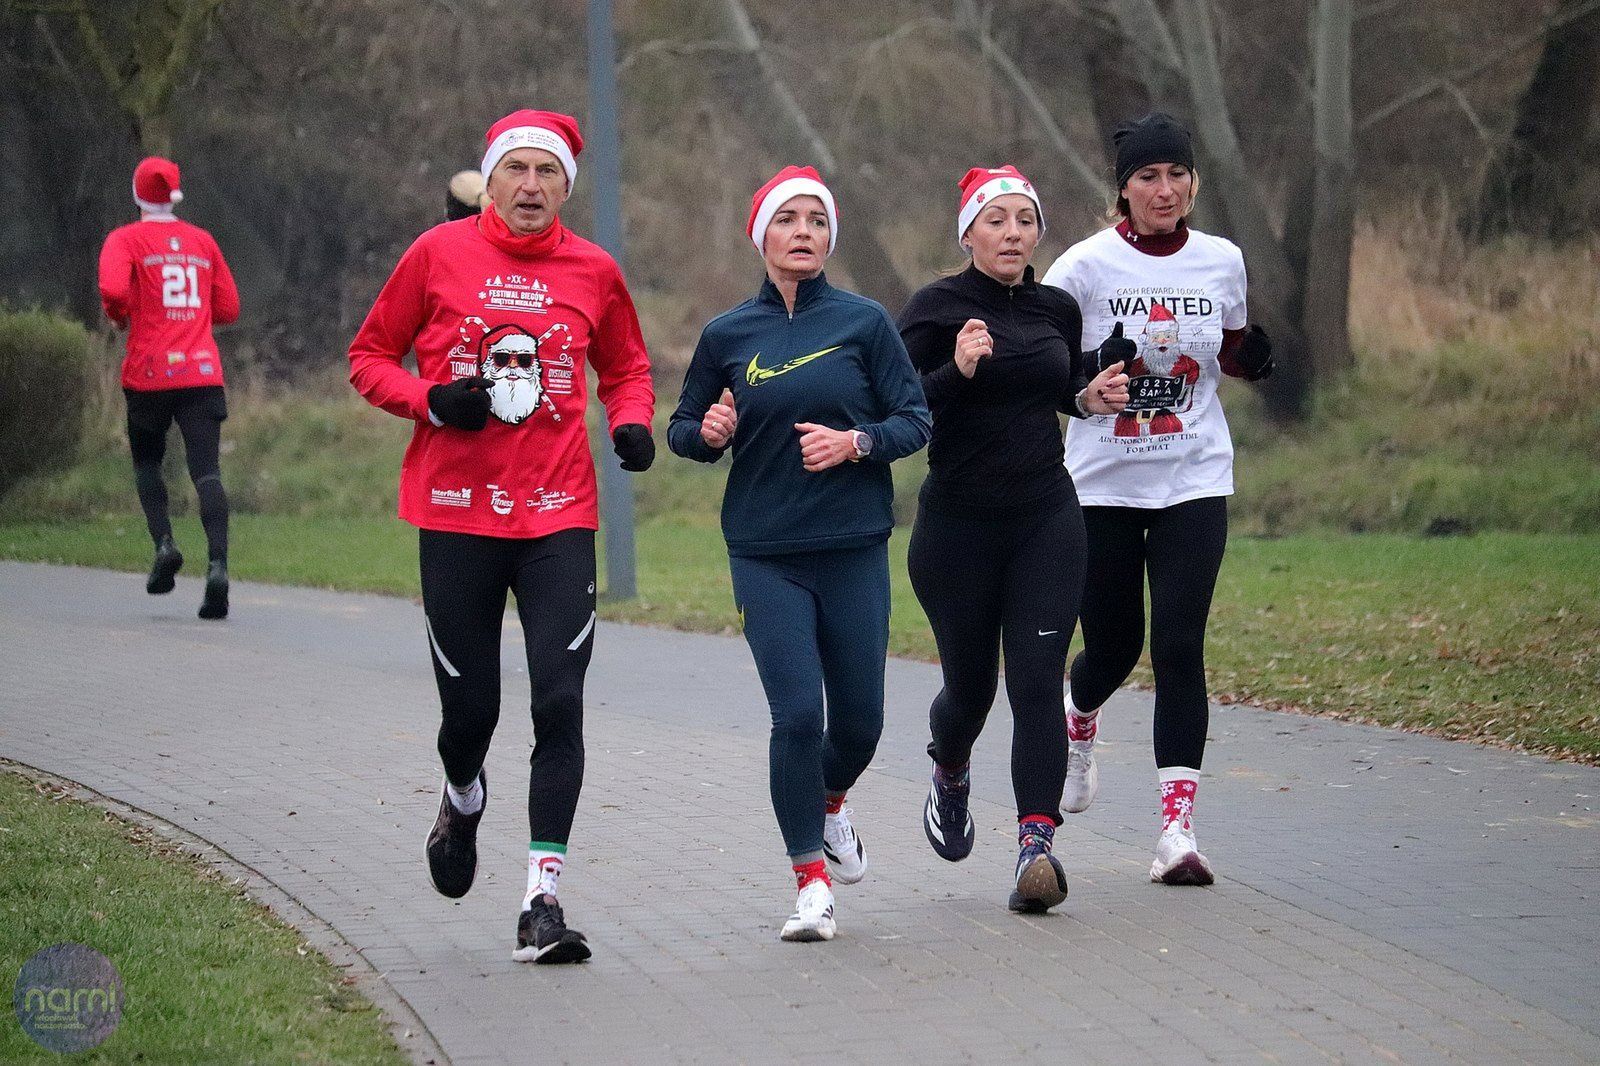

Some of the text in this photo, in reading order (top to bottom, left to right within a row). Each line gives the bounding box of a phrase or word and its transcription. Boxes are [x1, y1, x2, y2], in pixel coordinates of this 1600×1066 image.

[162, 264, 202, 309] 21
[1116, 287, 1140, 296] CASH
[1141, 286, 1174, 295] REWARD
[488, 289, 545, 302] FESTIWAL BIEGÓW
[1108, 297, 1213, 316] WANTED
[450, 359, 477, 377] TORUŃ
[1120, 436, 1154, 445] NOBODY
[1158, 434, 1176, 442] GOT
[1179, 432, 1199, 440] TIME
[1126, 443, 1171, 454] FOR THAT
[431, 487, 462, 498] InterRisk
